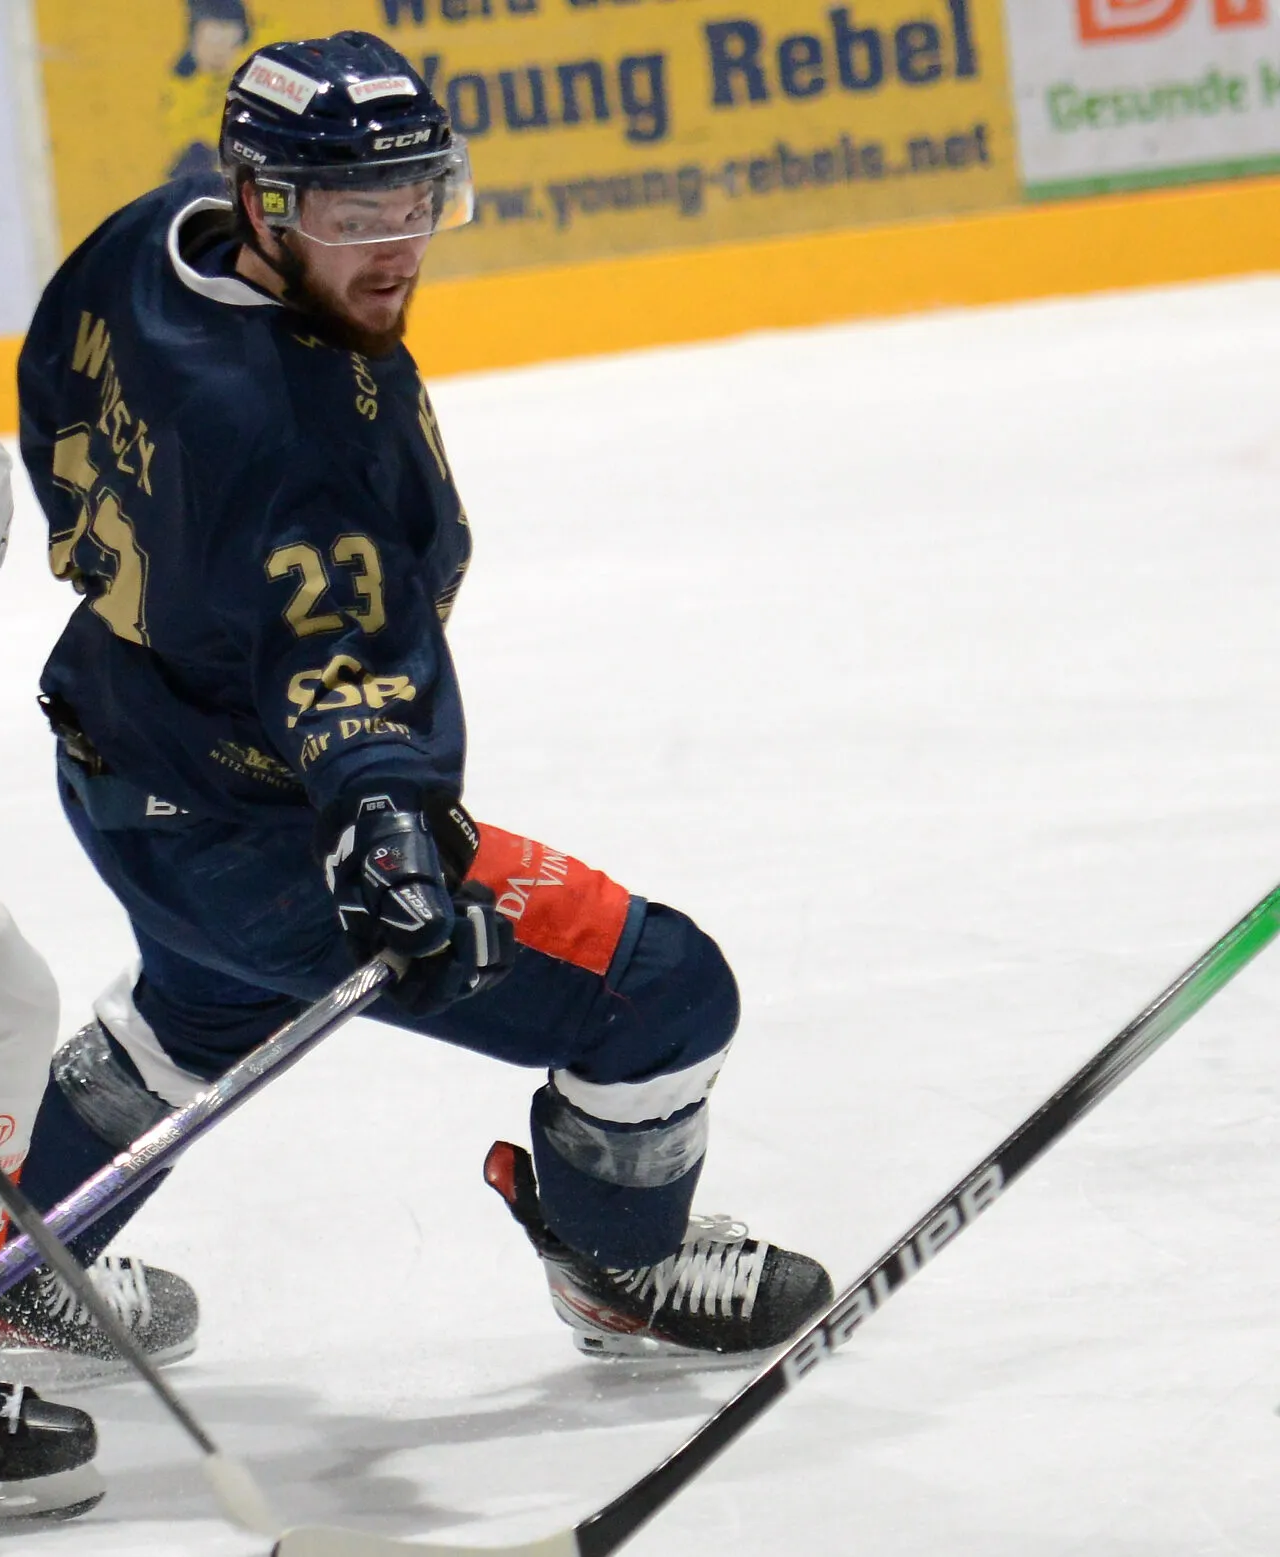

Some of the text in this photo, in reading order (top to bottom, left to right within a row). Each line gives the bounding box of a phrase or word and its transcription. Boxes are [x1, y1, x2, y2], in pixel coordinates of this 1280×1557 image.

[703, 0, 978, 107] Rebel
[232, 141, 268, 165] CCM
[372, 128, 431, 151] CCM
[264, 533, 387, 638] 23
[448, 808, 479, 850] CCM
[400, 887, 433, 920] CCM
[782, 1163, 1006, 1391] BAUER
